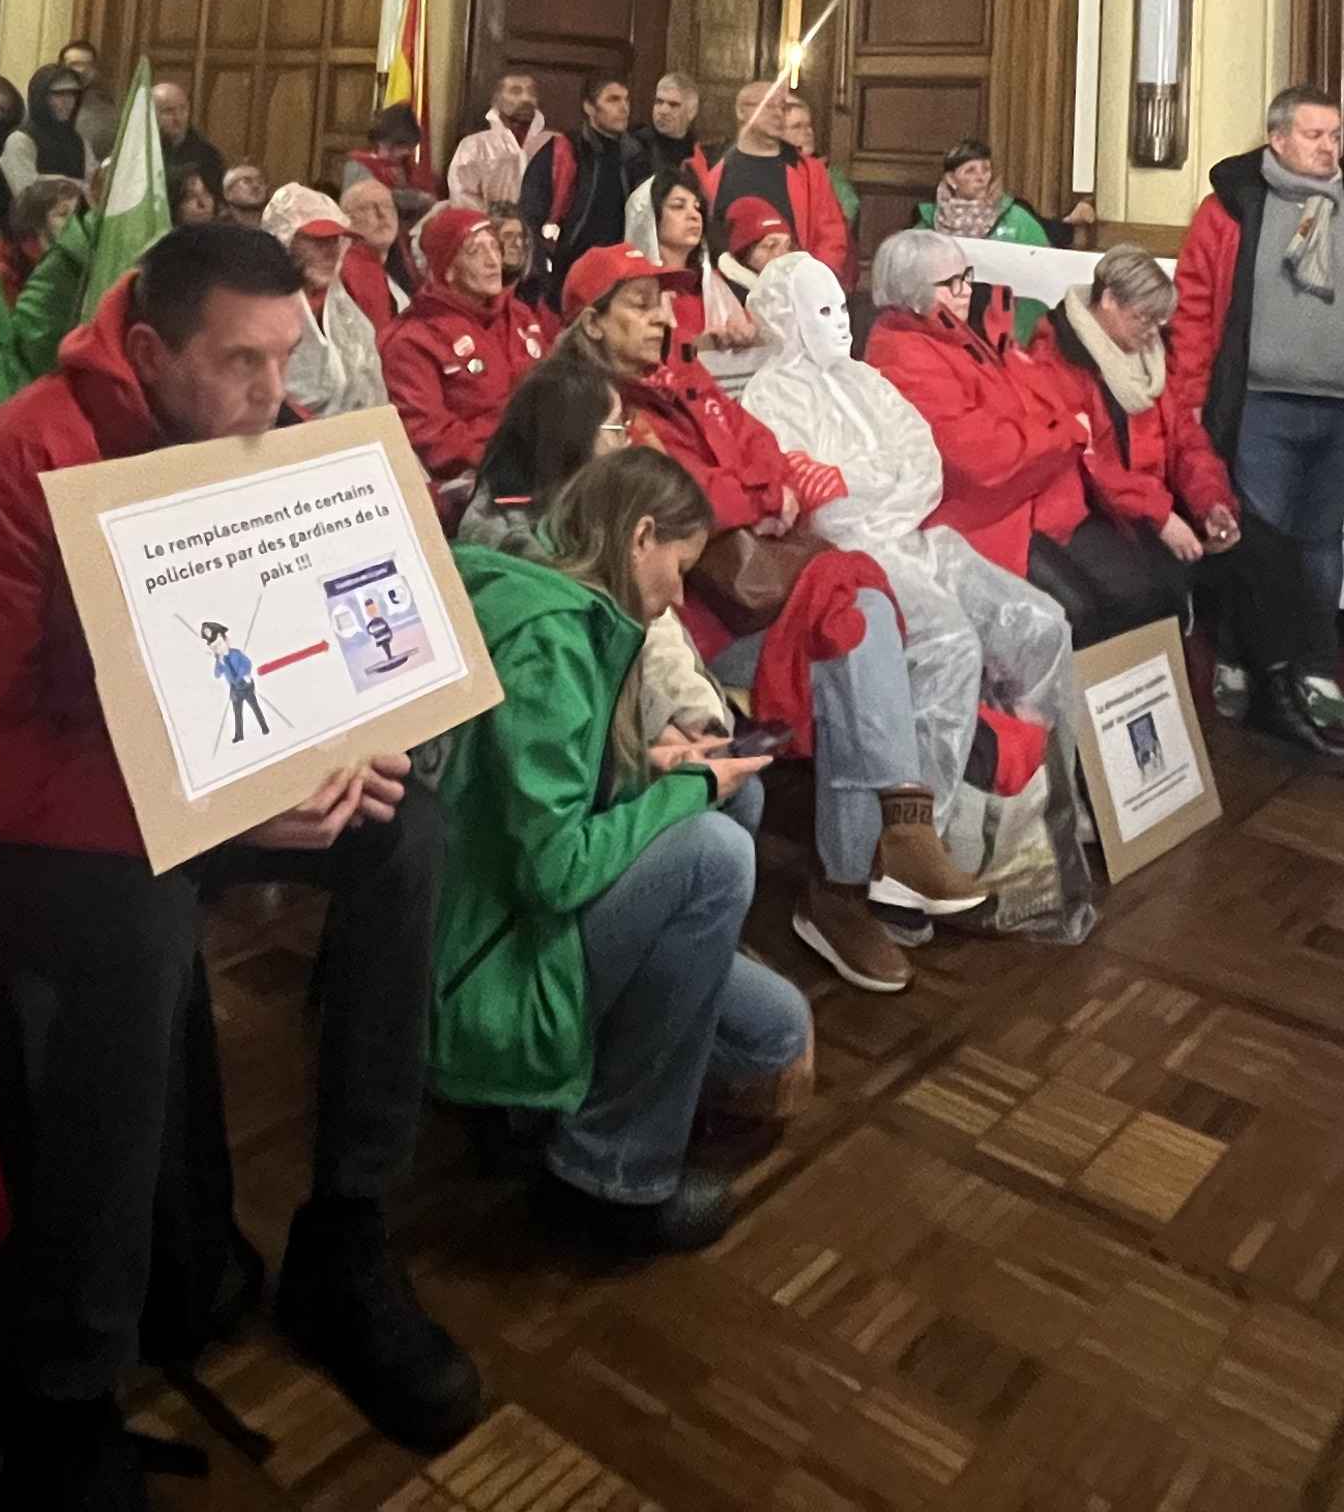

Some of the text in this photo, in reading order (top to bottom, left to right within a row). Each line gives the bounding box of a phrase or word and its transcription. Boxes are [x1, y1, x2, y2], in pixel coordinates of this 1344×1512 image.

[143, 483, 375, 559] Le remplacement de certains
[145, 504, 390, 594] policiers par des gardiens de la
[259, 562, 294, 587] paix
